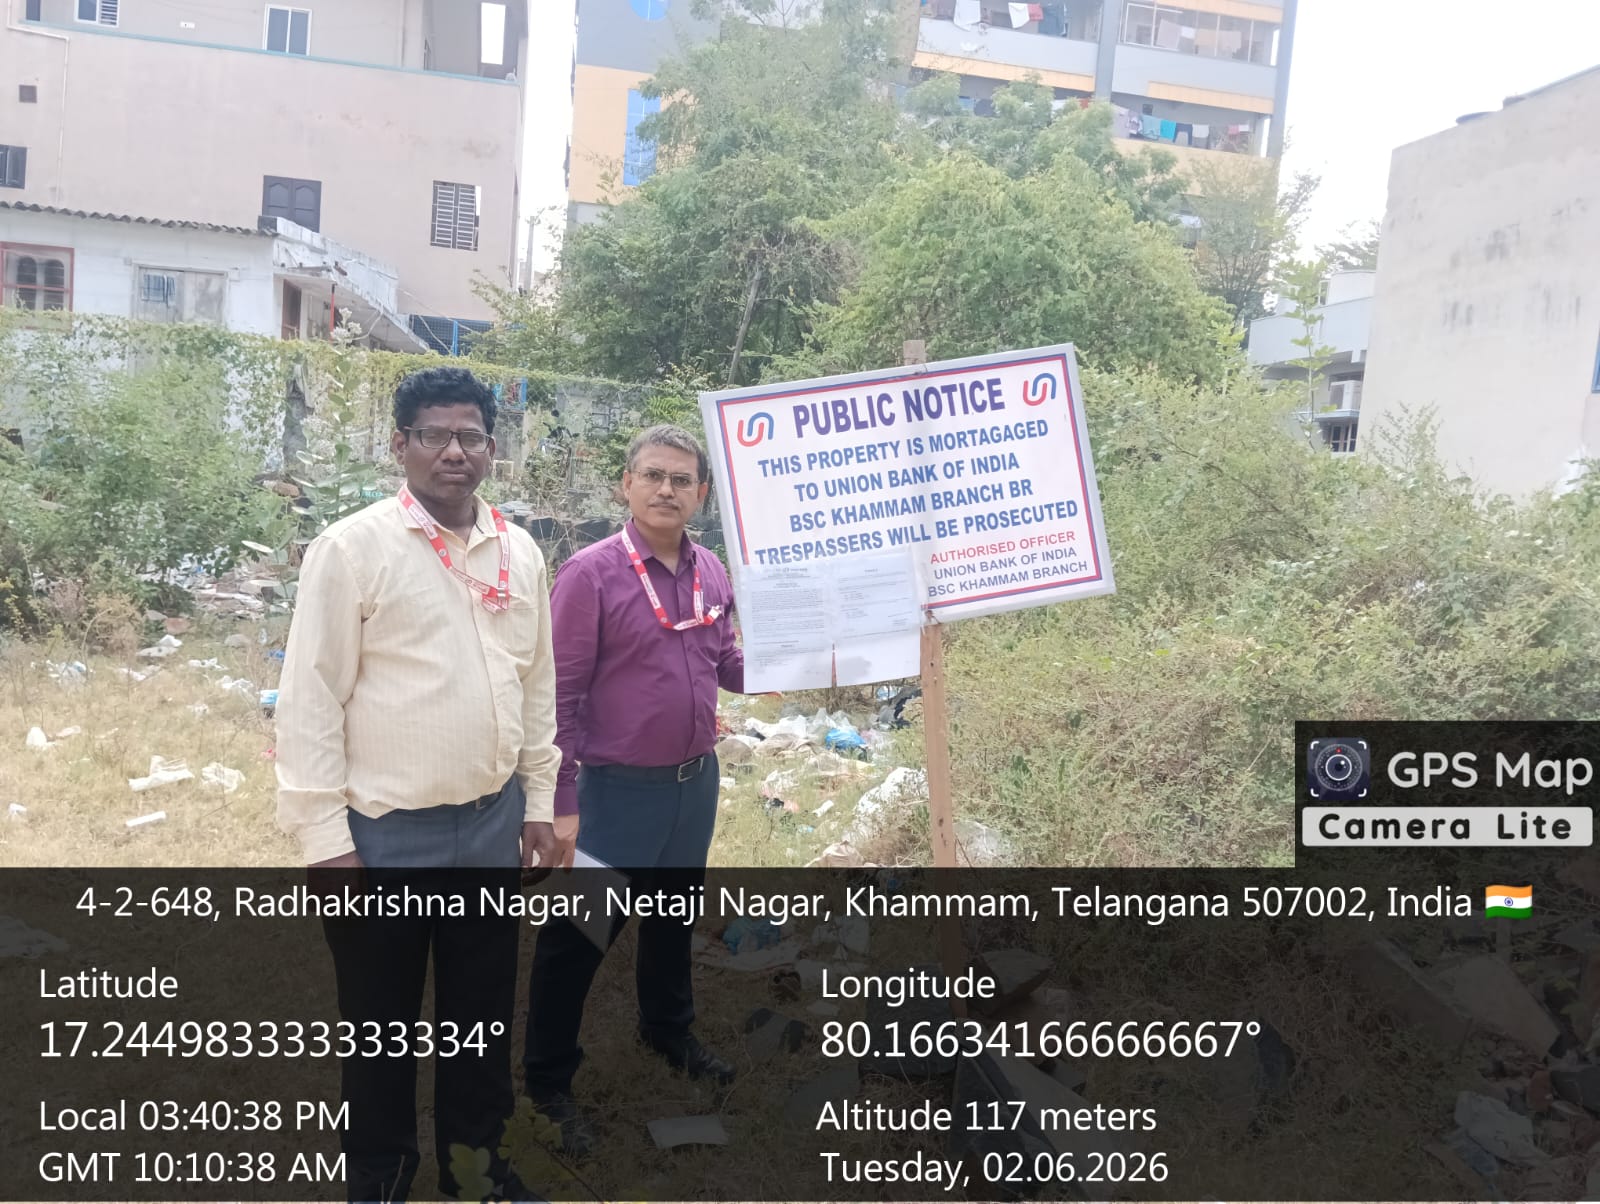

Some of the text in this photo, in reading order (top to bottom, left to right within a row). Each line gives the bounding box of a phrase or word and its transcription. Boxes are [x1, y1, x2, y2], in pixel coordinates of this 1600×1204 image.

[793, 378, 1006, 438] PUBLIC NOTICE
[757, 420, 1049, 477] THIS PROPERTY IS MORTAGAGED
[794, 452, 1020, 502] TO UNION BANK OF INDIA
[790, 479, 1034, 532] BSC KHAMMAM BRANCH BR
[754, 500, 1078, 565] TRESPASSERS WILL BE PROSECUTED
[930, 531, 1076, 564] AUTHORISED OFFICER
[928, 561, 1088, 597] BSC KHAMMAM BRANCH
[934, 547, 1077, 579] UNION BANK OF INDIA
